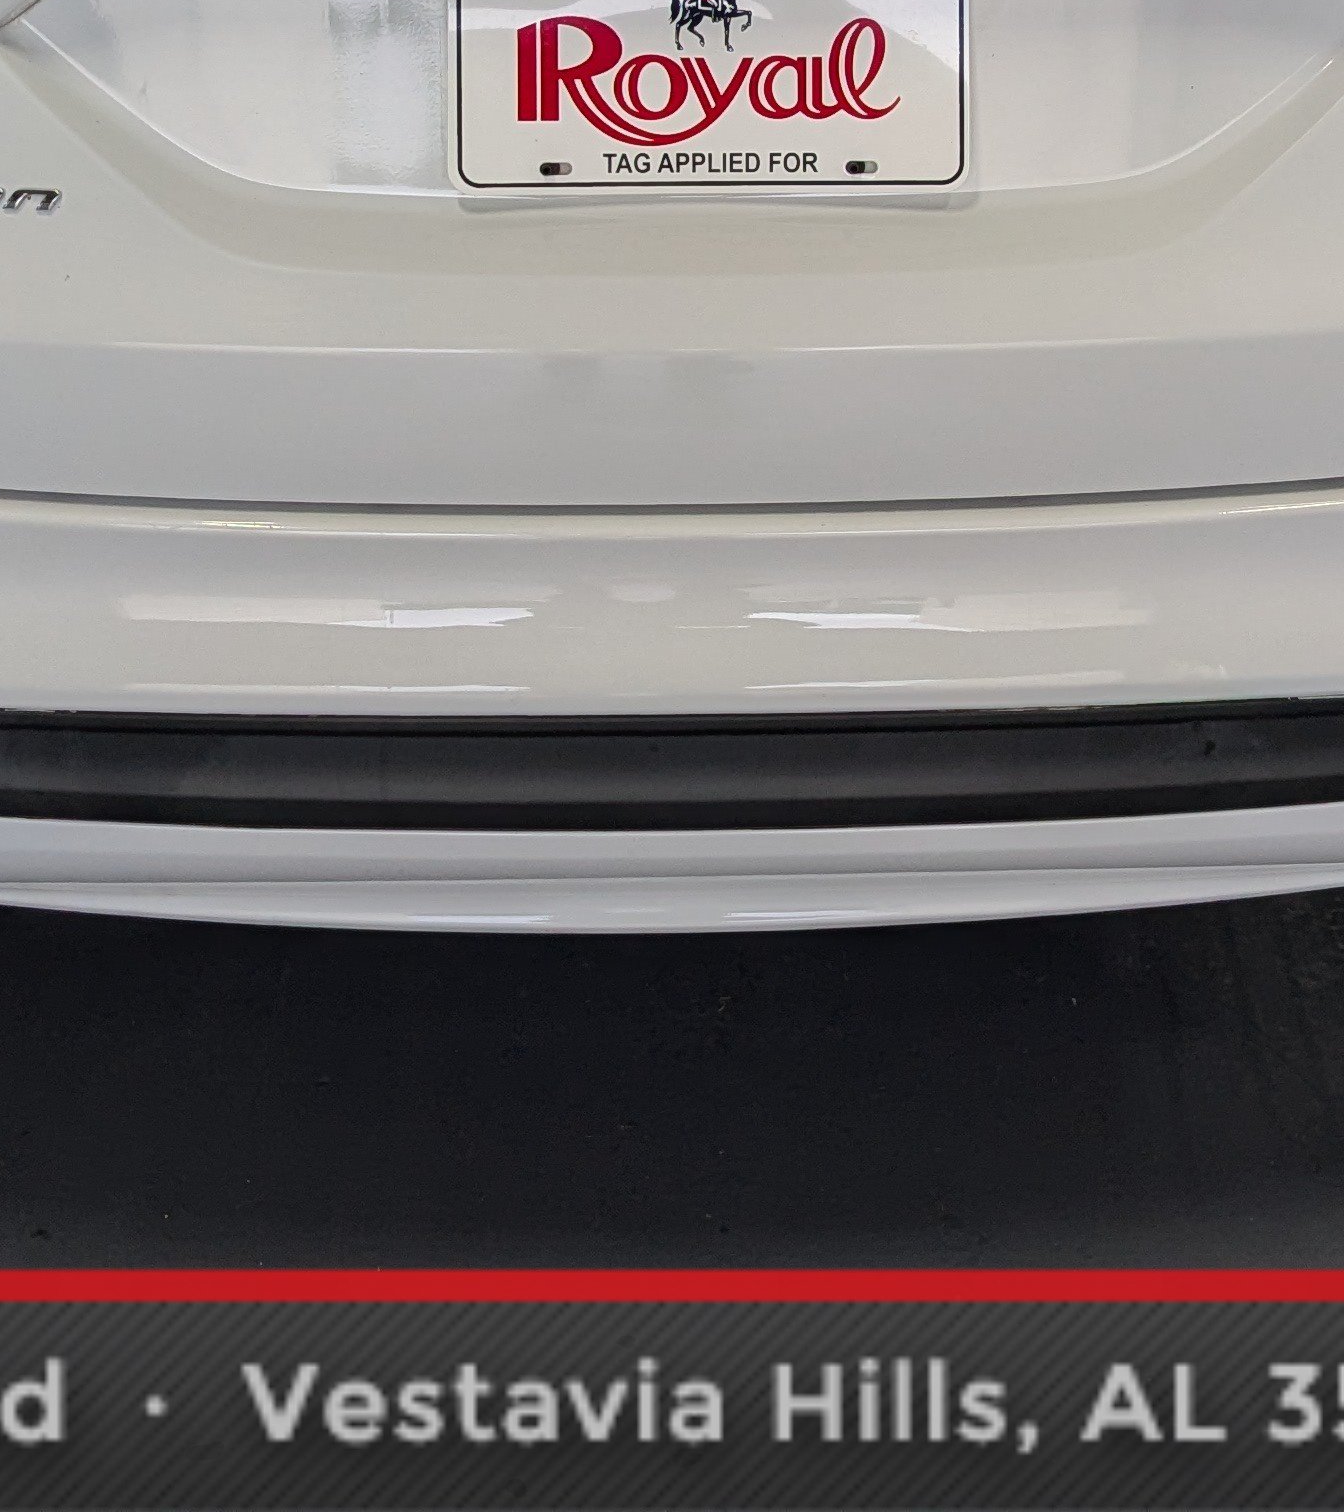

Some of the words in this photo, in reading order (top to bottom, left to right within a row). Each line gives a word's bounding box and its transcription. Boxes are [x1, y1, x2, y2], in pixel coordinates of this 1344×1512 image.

[515, 15, 901, 148] Royal
[602, 153, 652, 174] TAG
[657, 153, 761, 174] APPLIED
[768, 152, 819, 173] FOR
